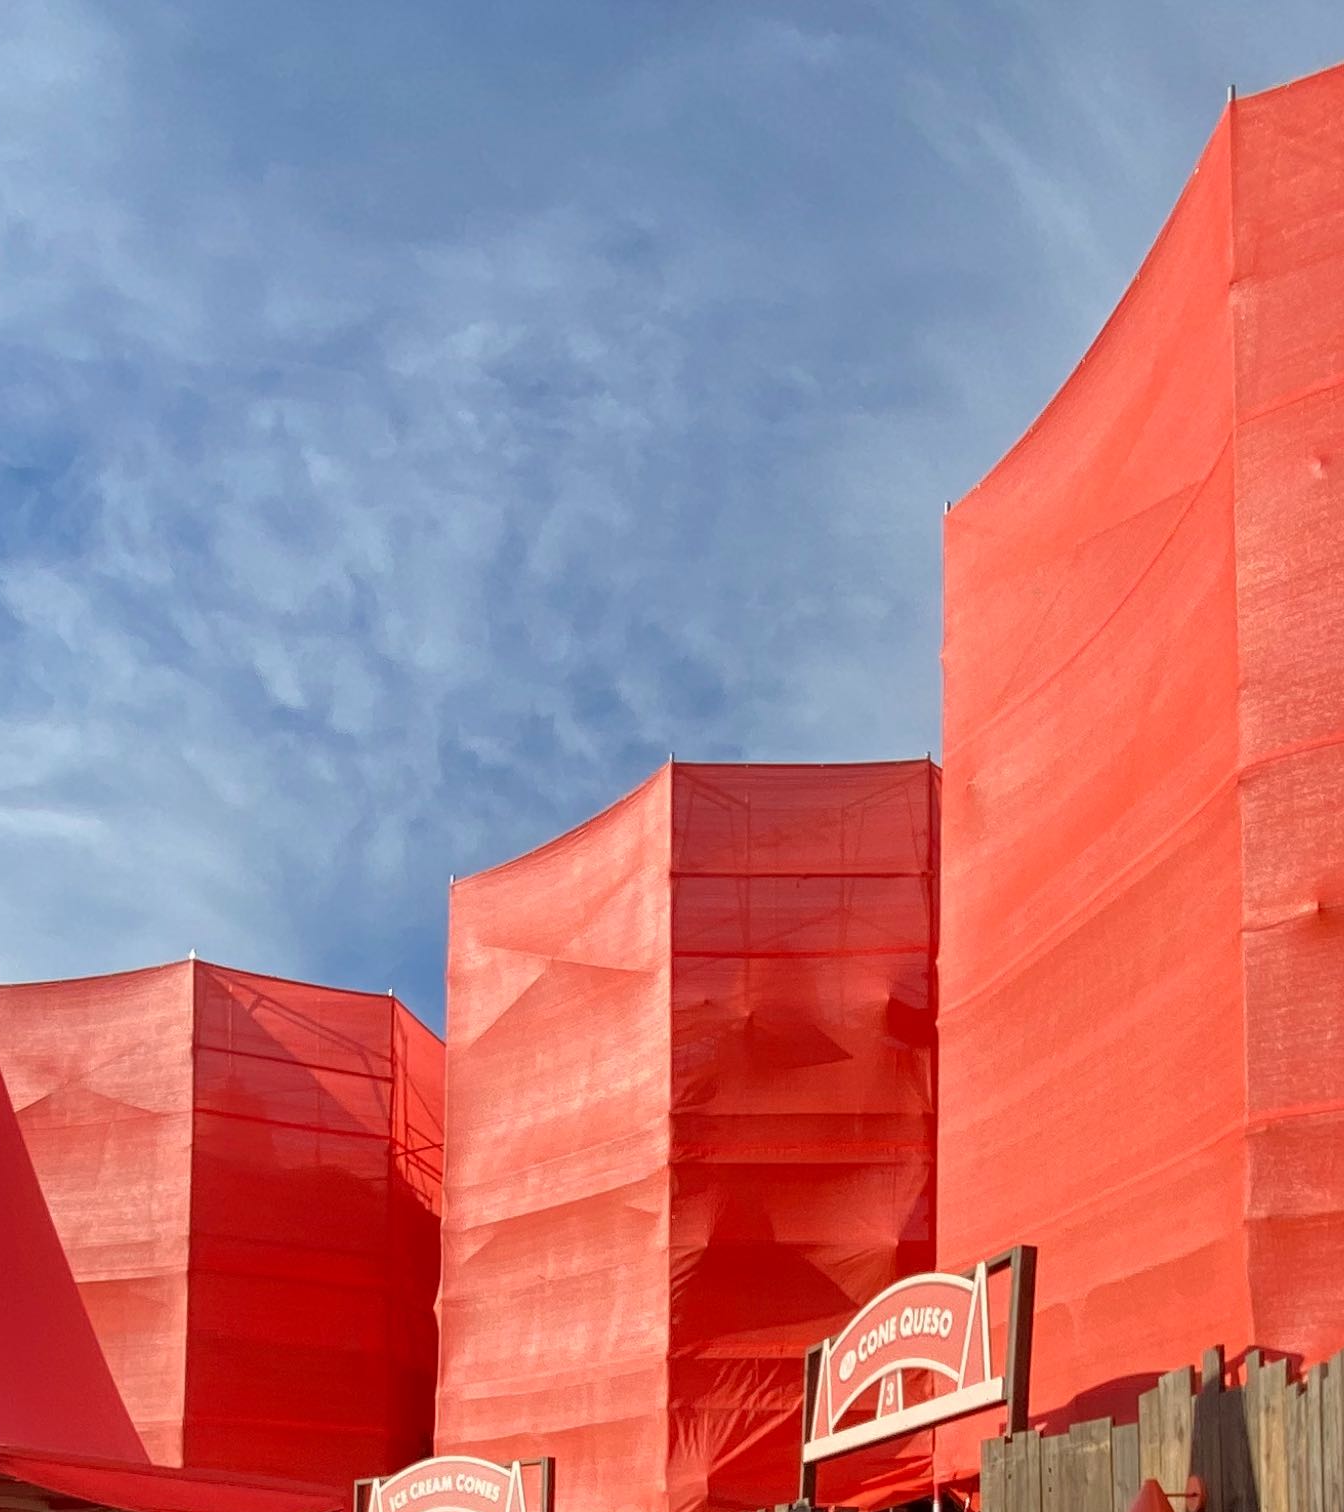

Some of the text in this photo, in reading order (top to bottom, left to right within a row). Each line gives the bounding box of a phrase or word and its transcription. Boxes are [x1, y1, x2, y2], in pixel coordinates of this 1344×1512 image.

[858, 1306, 953, 1362] CONE QUESO
[885, 1381, 895, 1406] 3
[389, 1473, 500, 1512] ICE CREAM CONES
